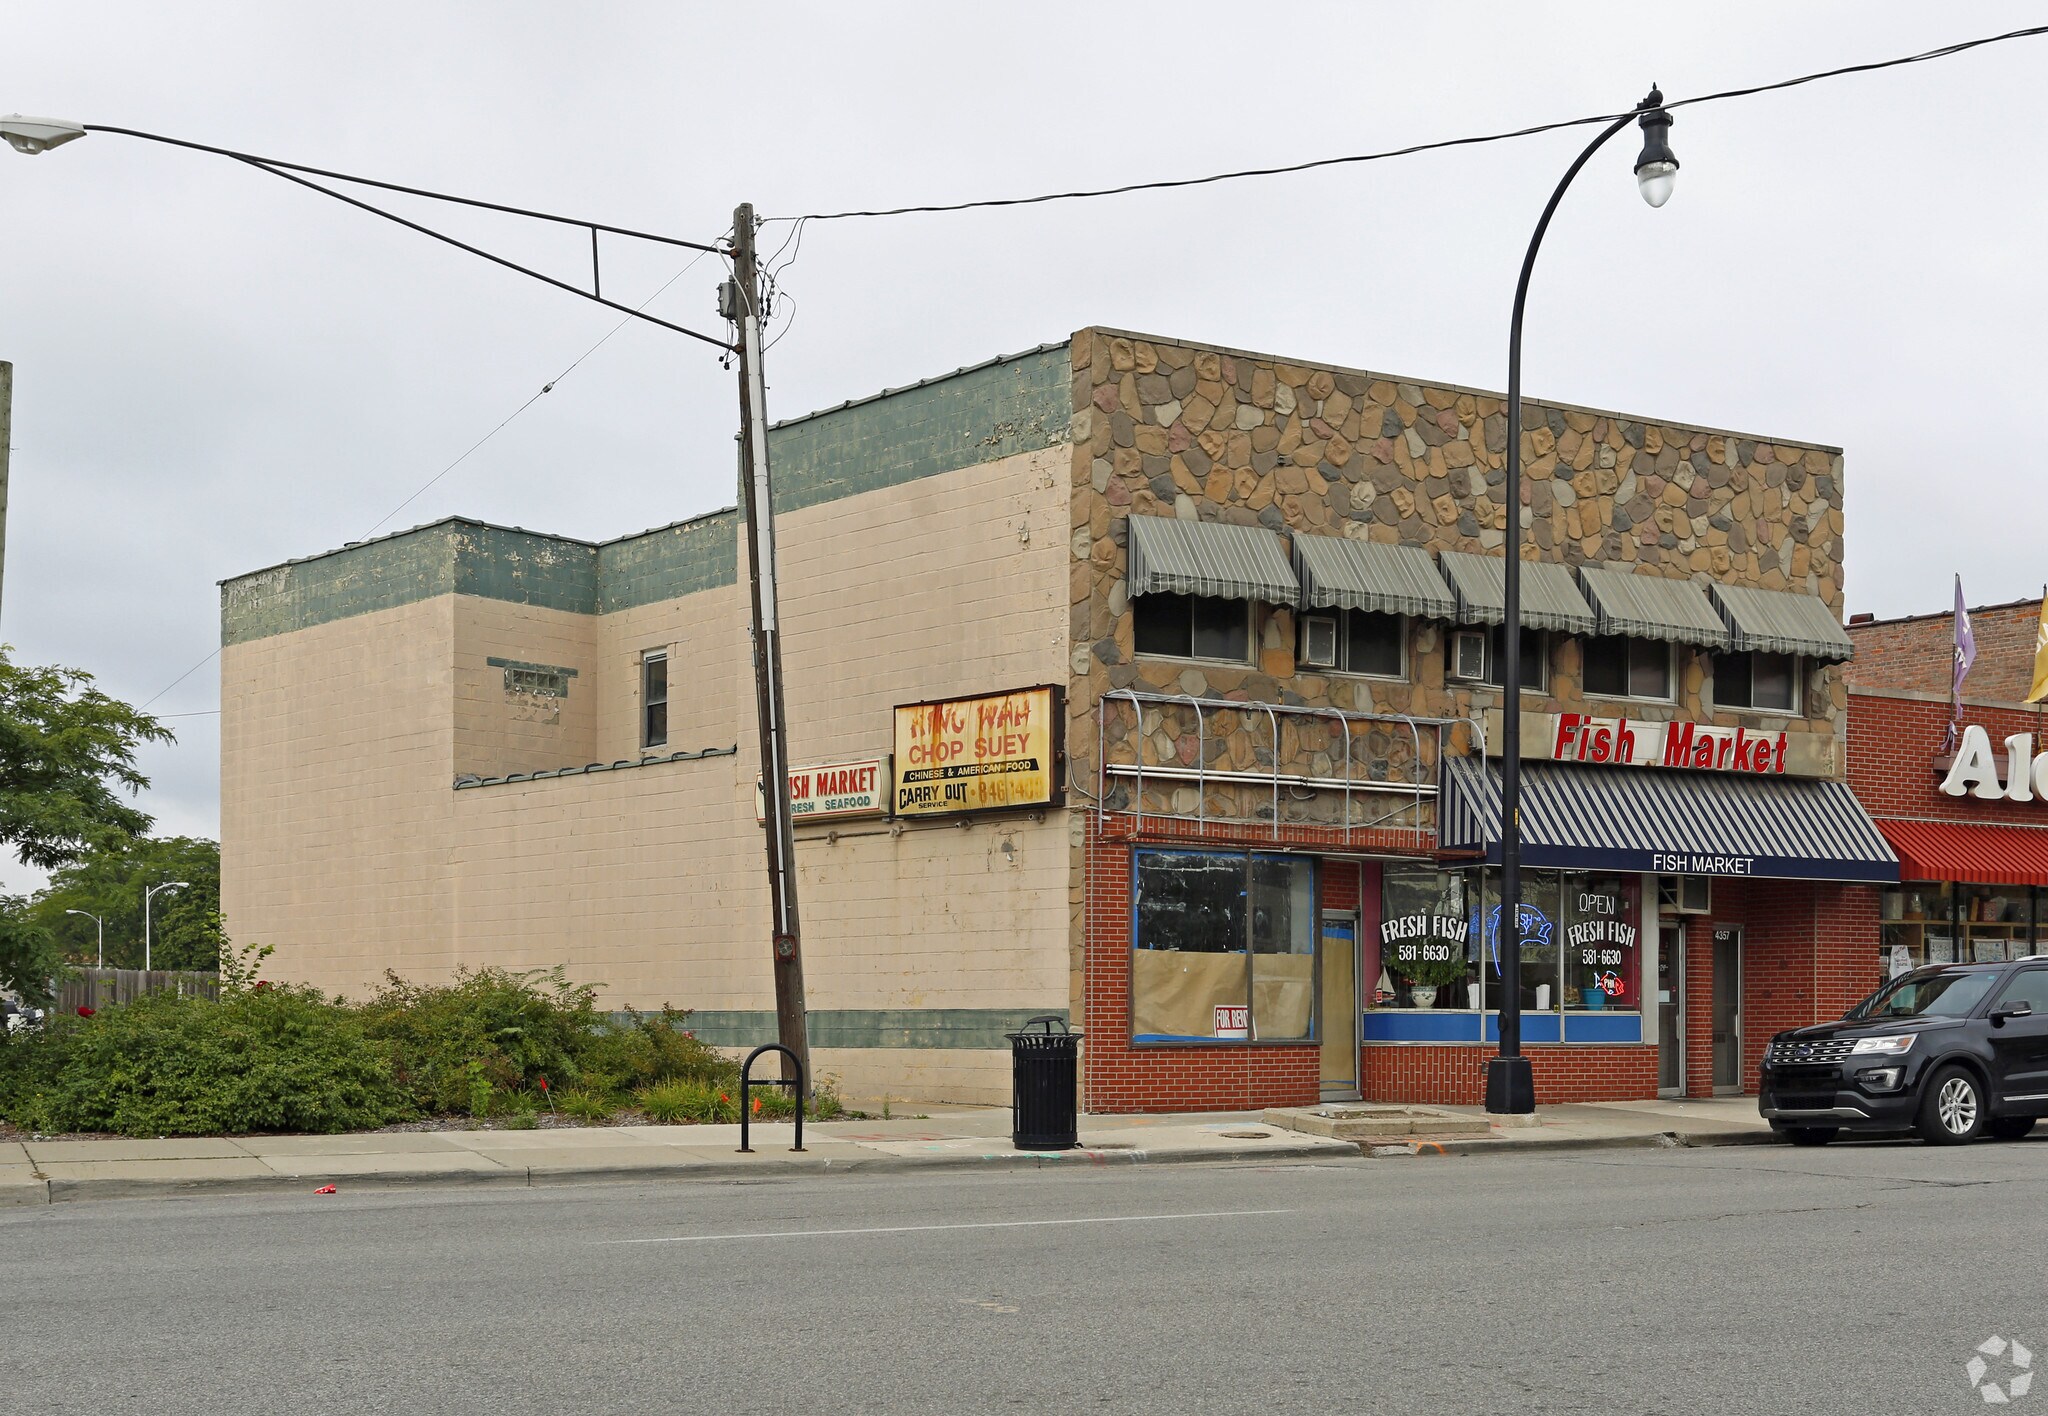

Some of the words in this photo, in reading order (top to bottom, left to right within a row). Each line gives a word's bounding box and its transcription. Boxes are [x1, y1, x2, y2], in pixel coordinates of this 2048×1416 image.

[909, 740, 964, 765] CHOP
[974, 733, 1030, 758] SUEY
[1553, 713, 1635, 763] Fish
[1663, 721, 1788, 773] Market
[909, 769, 945, 781] CHINESE
[947, 768, 954, 777] &
[957, 764, 1001, 776] AMERICAN
[1005, 761, 1031, 772] FOOD
[789, 774, 810, 800] ISH
[816, 766, 876, 797] MARKET
[790, 802, 815, 813] RESH
[825, 795, 871, 810] SEAFOOD
[899, 785, 940, 810] CARRY
[945, 783, 968, 803] OUT
[918, 801, 948, 809] SERVICE
[1653, 854, 1688, 871] FISH
[1692, 856, 1754, 874] MARKET
[1579, 893, 1615, 915] OPEN
[1381, 915, 1427, 944] FRESH
[1433, 915, 1468, 943] FISH
[1567, 920, 1604, 948] FRESH
[1608, 921, 1636, 948] FISH
[1715, 931, 1730, 940] 4357
[1398, 944, 1449, 961] 581-6630
[1582, 949, 1621, 965] 581-6630
[1216, 1009, 1230, 1028] FOR
[1231, 1009, 1249, 1028] REN
